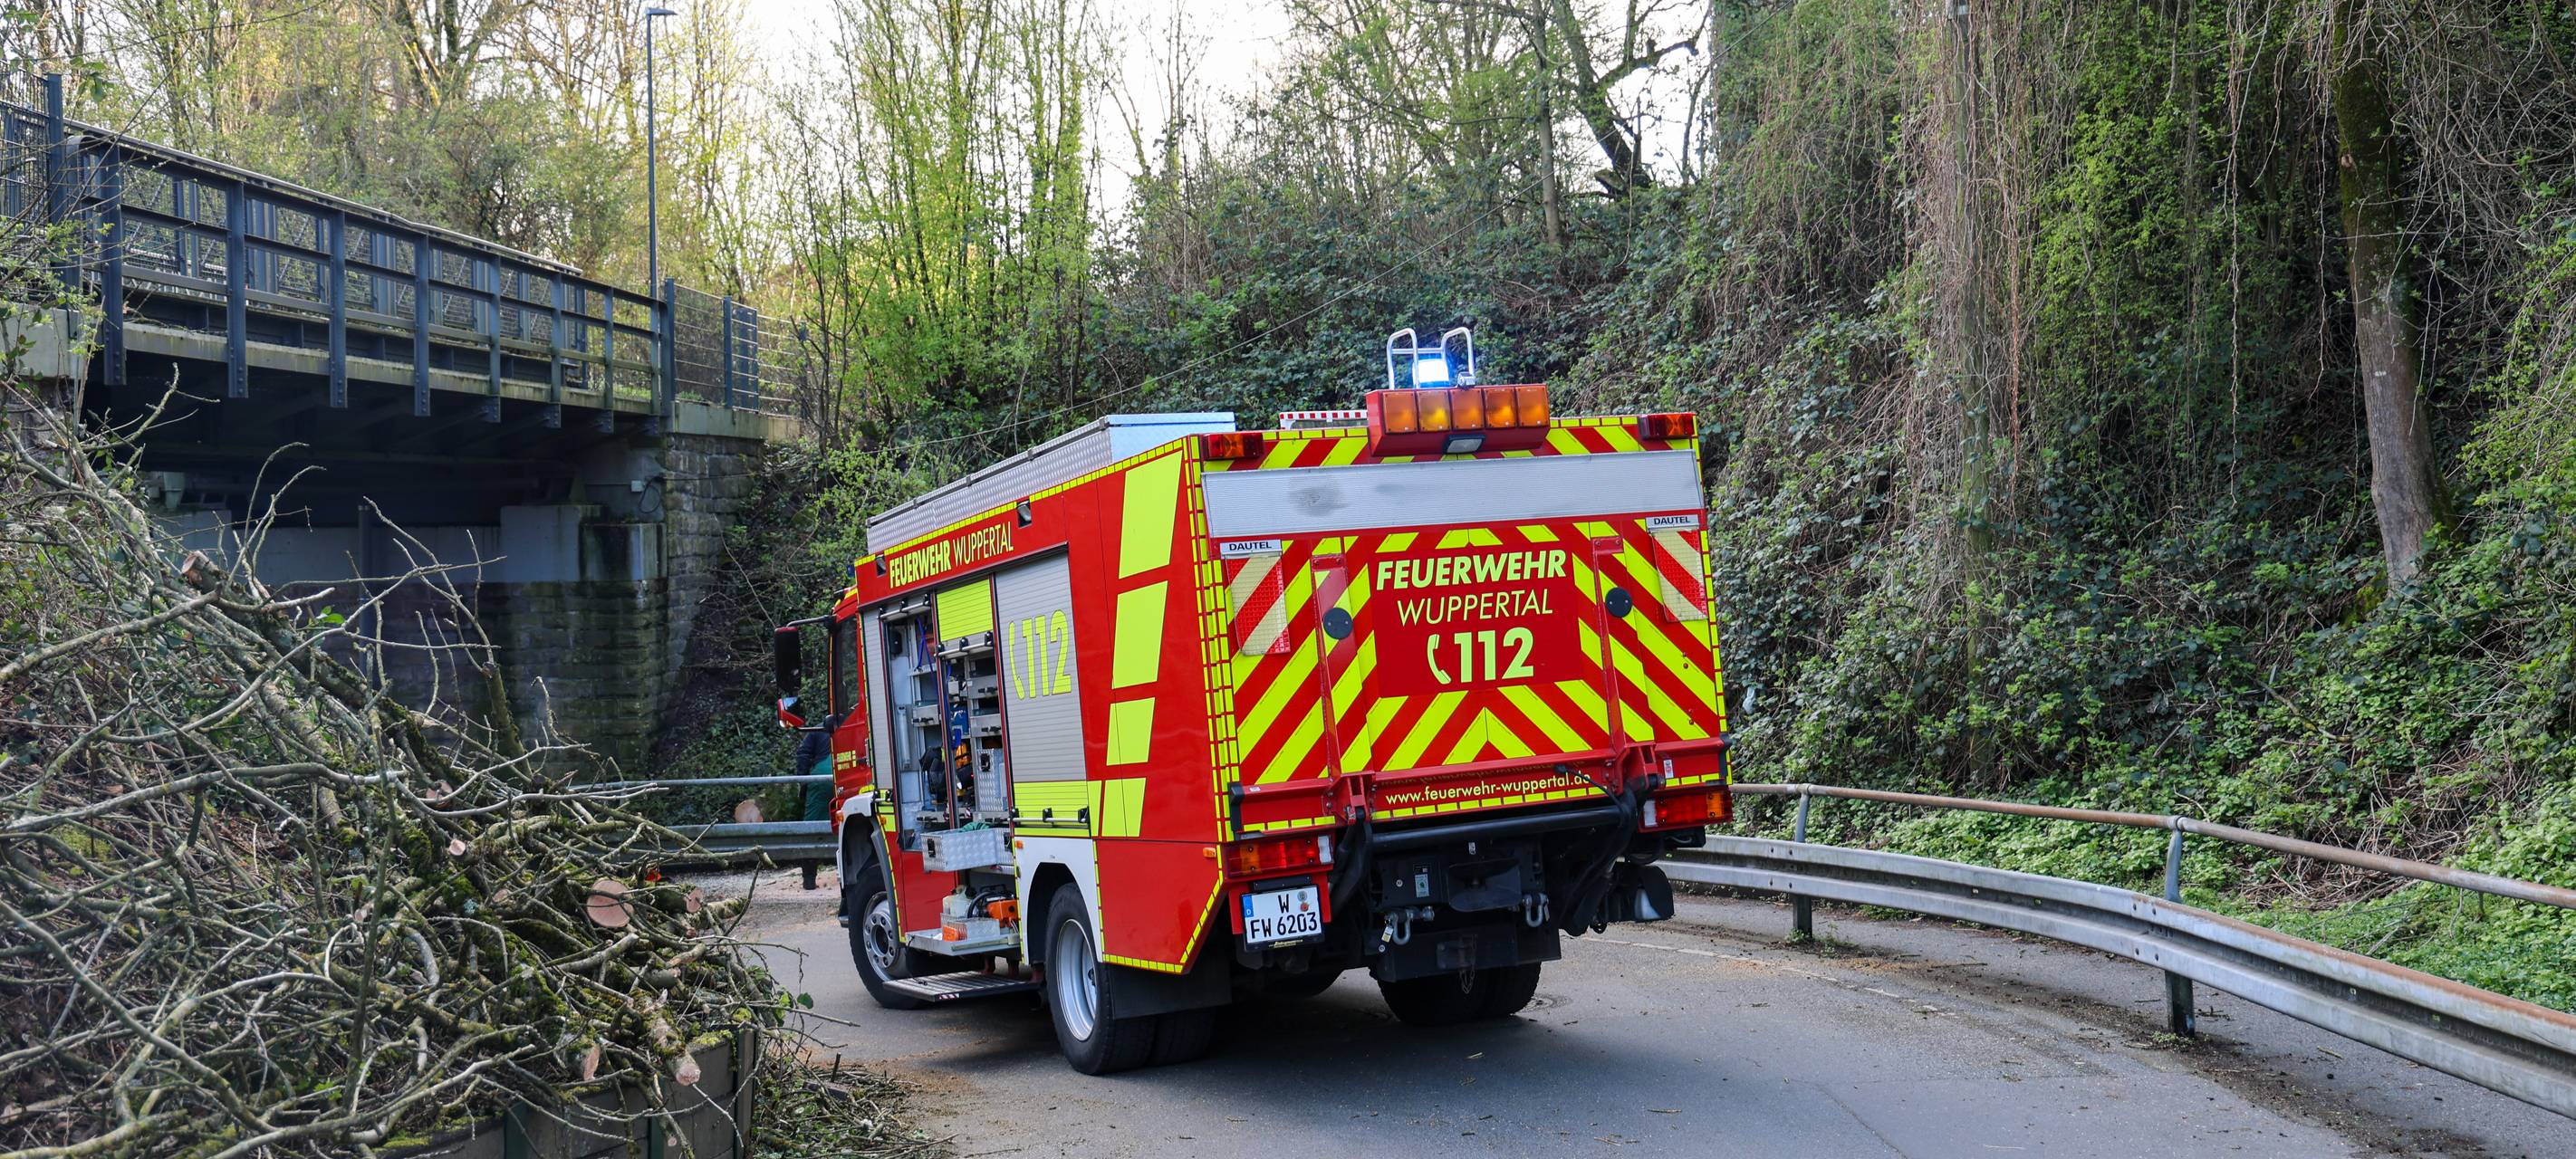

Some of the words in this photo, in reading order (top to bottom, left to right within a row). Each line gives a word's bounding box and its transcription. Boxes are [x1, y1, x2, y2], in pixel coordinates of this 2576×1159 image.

[1654, 516, 1690, 525] DAUTEL
[889, 540, 951, 589] FEUERWEHR
[952, 521, 1014, 567] WUPPERTAL
[1228, 541, 1273, 551] DAUTEL
[1376, 549, 1567, 590] FEUERWEHR
[1397, 589, 1553, 627] WUPPERTAL
[1021, 608, 1072, 699] 112
[1453, 627, 1534, 684] 112
[1386, 770, 1591, 805] www.feuerwehr-wuppertal.de
[1277, 893, 1290, 914] W
[1250, 917, 1272, 939] FW
[1276, 912, 1318, 935] 6203
